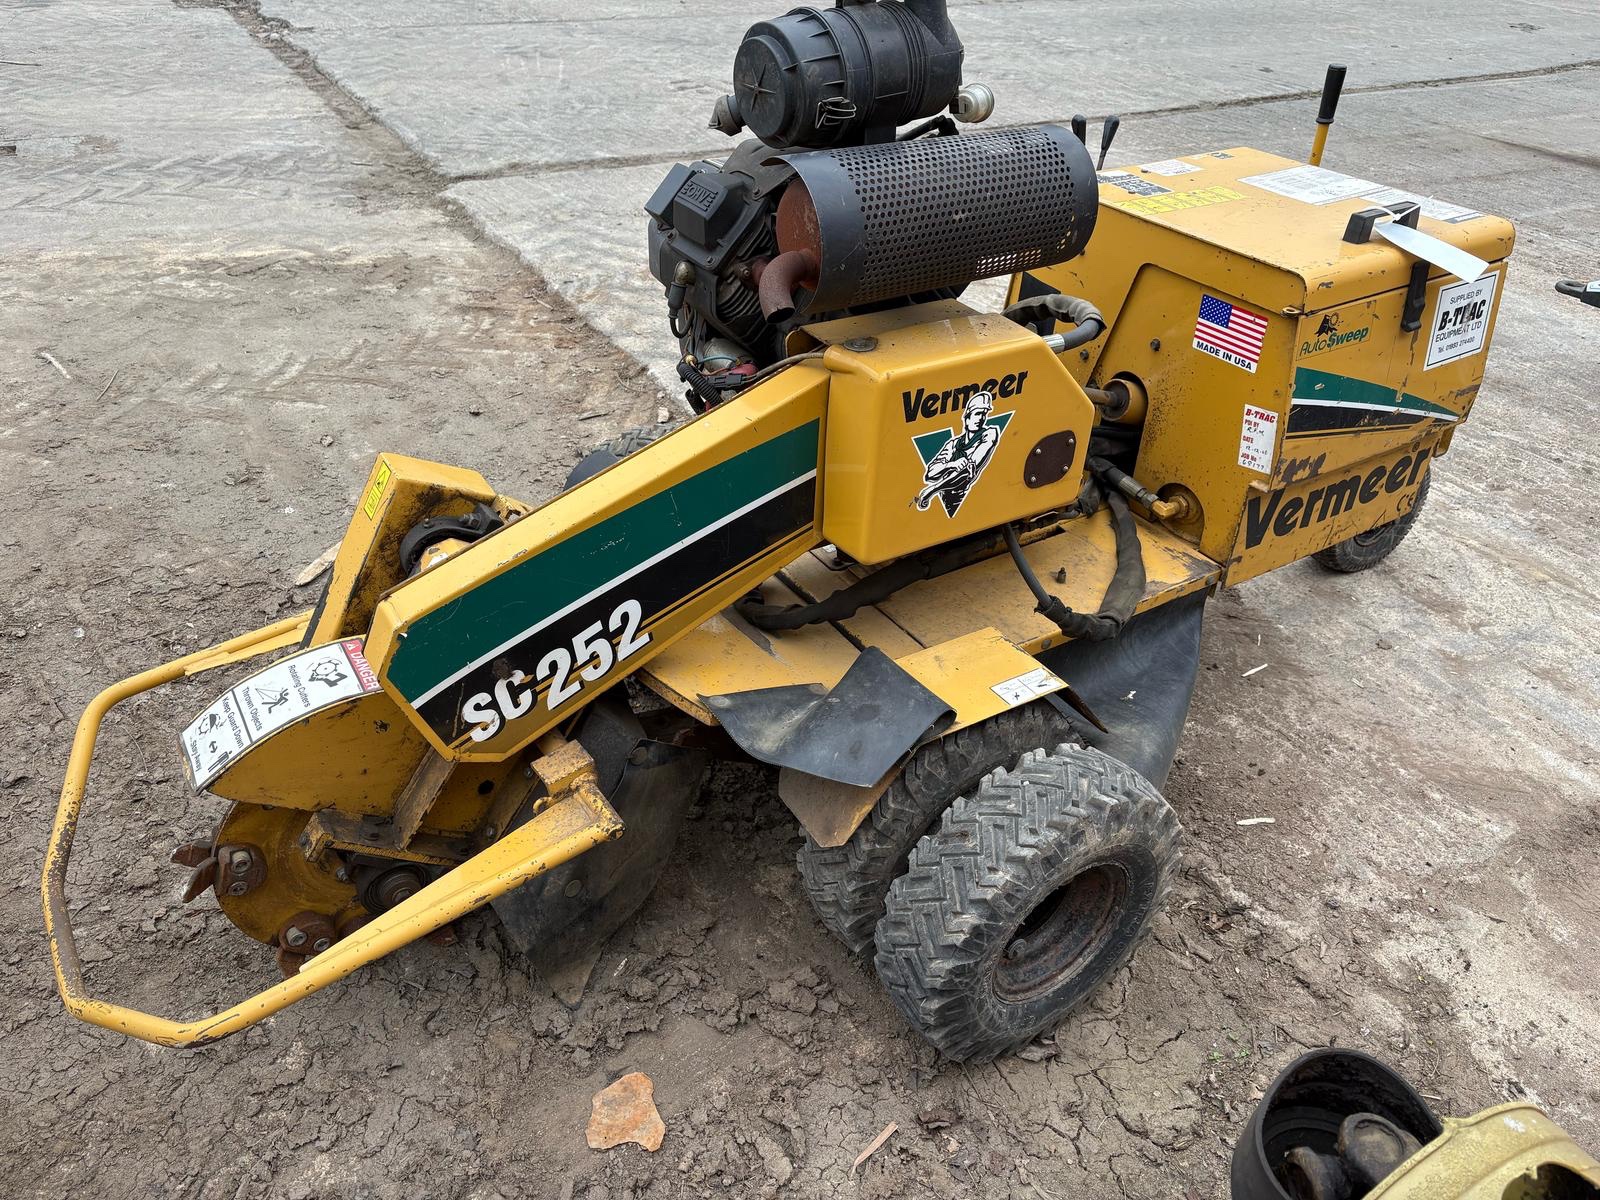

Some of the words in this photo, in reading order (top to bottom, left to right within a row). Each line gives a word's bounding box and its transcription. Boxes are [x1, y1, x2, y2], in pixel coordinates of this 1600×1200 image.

[1450, 291, 1475, 304] SUPPLIED
[1475, 288, 1483, 297] BY
[1435, 324, 1470, 342] EQUIPMENT
[1471, 320, 1482, 331] LTD
[1196, 340, 1221, 357] MADE
[1222, 351, 1232, 362] IN
[1234, 356, 1252, 370] USA
[902, 370, 1029, 423] Vermeer
[1245, 408, 1276, 424] B-TRAC
[1242, 435, 1254, 444] DATE
[1241, 452, 1250, 460] JOB
[1245, 446, 1432, 550] Vermeer
[350, 651, 379, 690] DANGER
[288, 664, 303, 689] Rotating
[297, 686, 311, 708] Cutters
[221, 696, 231, 714] Keep
[241, 686, 255, 710] Thrown
[250, 707, 263, 731] Objects
[227, 711, 240, 732] Guard
[233, 729, 245, 749] Down
[194, 753, 202, 773] Away
